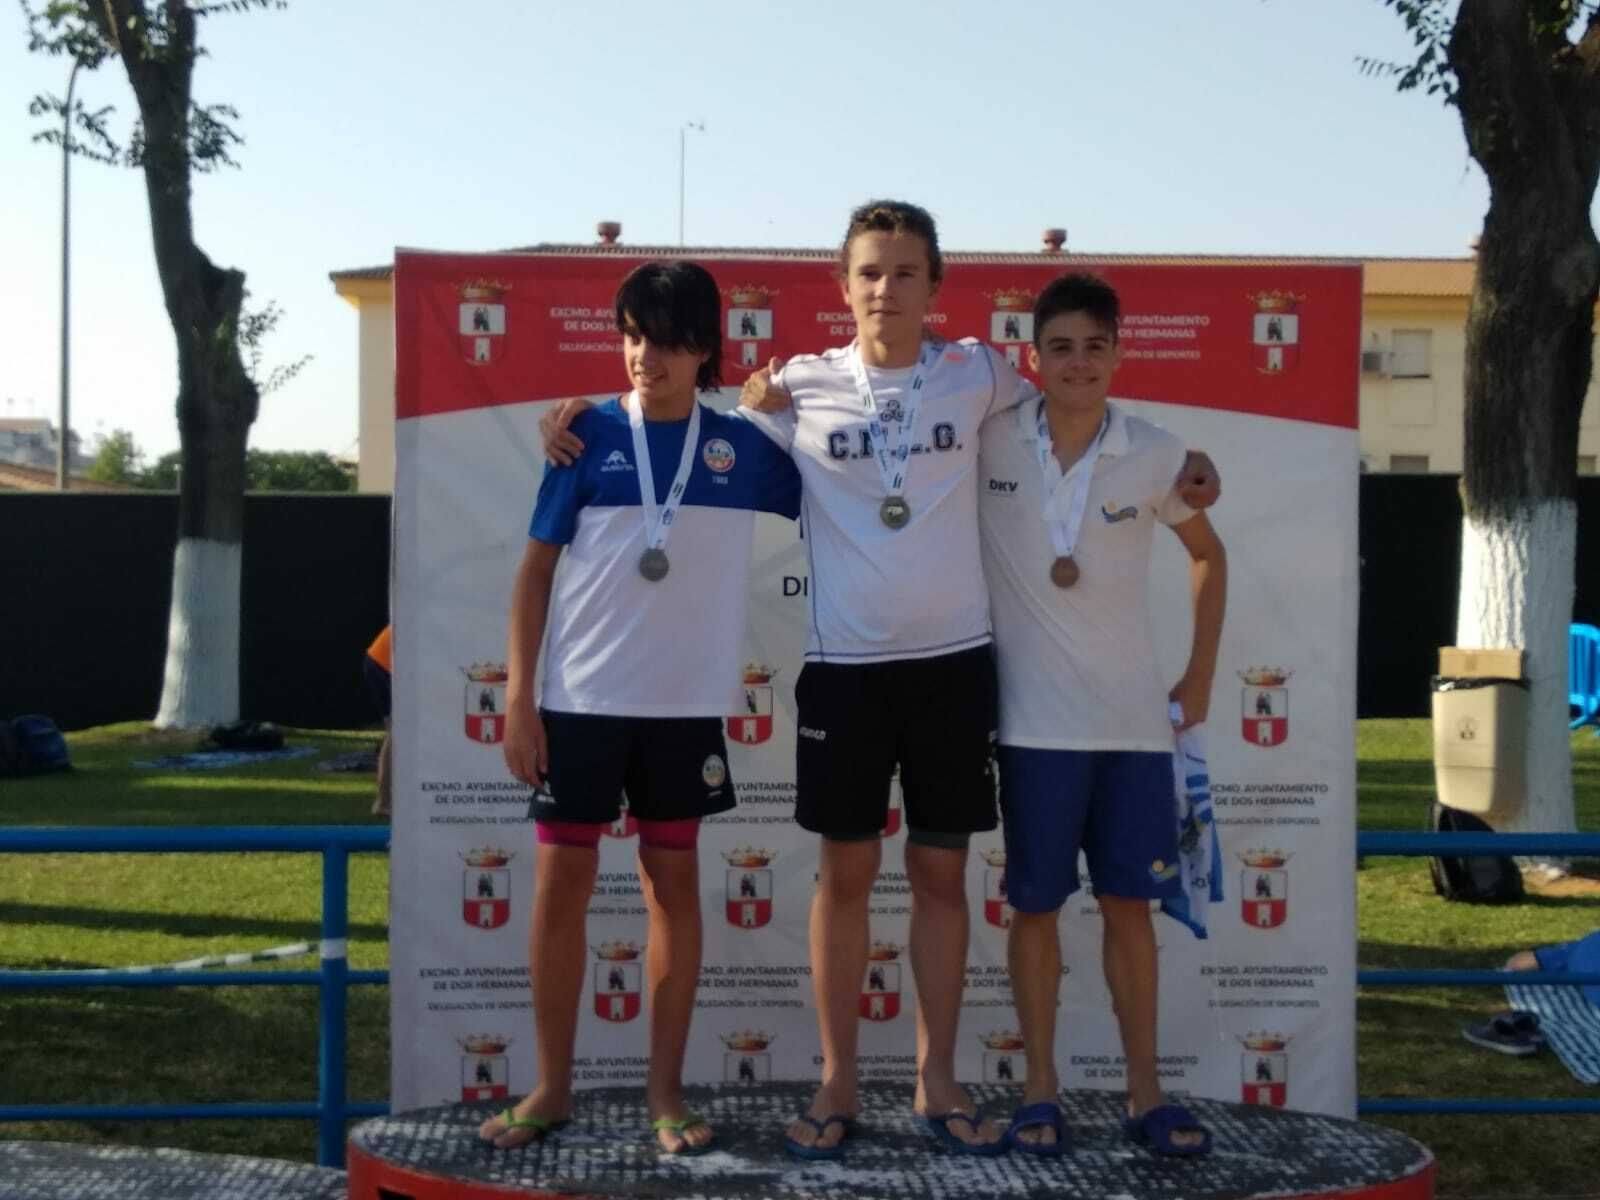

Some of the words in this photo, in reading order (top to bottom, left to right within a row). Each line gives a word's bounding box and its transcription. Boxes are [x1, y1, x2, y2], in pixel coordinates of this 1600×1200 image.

[1123, 314, 1210, 326] AYUNTAMIENTO
[564, 321, 577, 331] DE
[581, 321, 604, 331] DOS
[831, 325, 843, 335] DE
[1135, 328, 1196, 338] HERMANAS
[989, 478, 1018, 492] DKV
[1244, 783, 1329, 793] AYUNTAMIENTO
[435, 795, 448, 804] DE
[452, 795, 475, 804] DOS
[1215, 797, 1228, 805] DE
[1231, 797, 1253, 805] DOS
[1256, 796, 1315, 806] HERMANAS
[1277, 816, 1321, 826] DEPORTES
[727, 966, 812, 976] AYUNTAMIENTO
[1243, 966, 1328, 976] AYUNTAMIENTO
[433, 981, 447, 990] DE
[450, 980, 473, 990] DOS
[714, 979, 736, 988] DOS
[739, 978, 799, 988] HERMANAS
[1230, 978, 1252, 988] DOS
[1254, 978, 1315, 988] HERMANAS
[1084, 1068, 1097, 1078] DE
[1101, 1068, 1124, 1078] DOS
